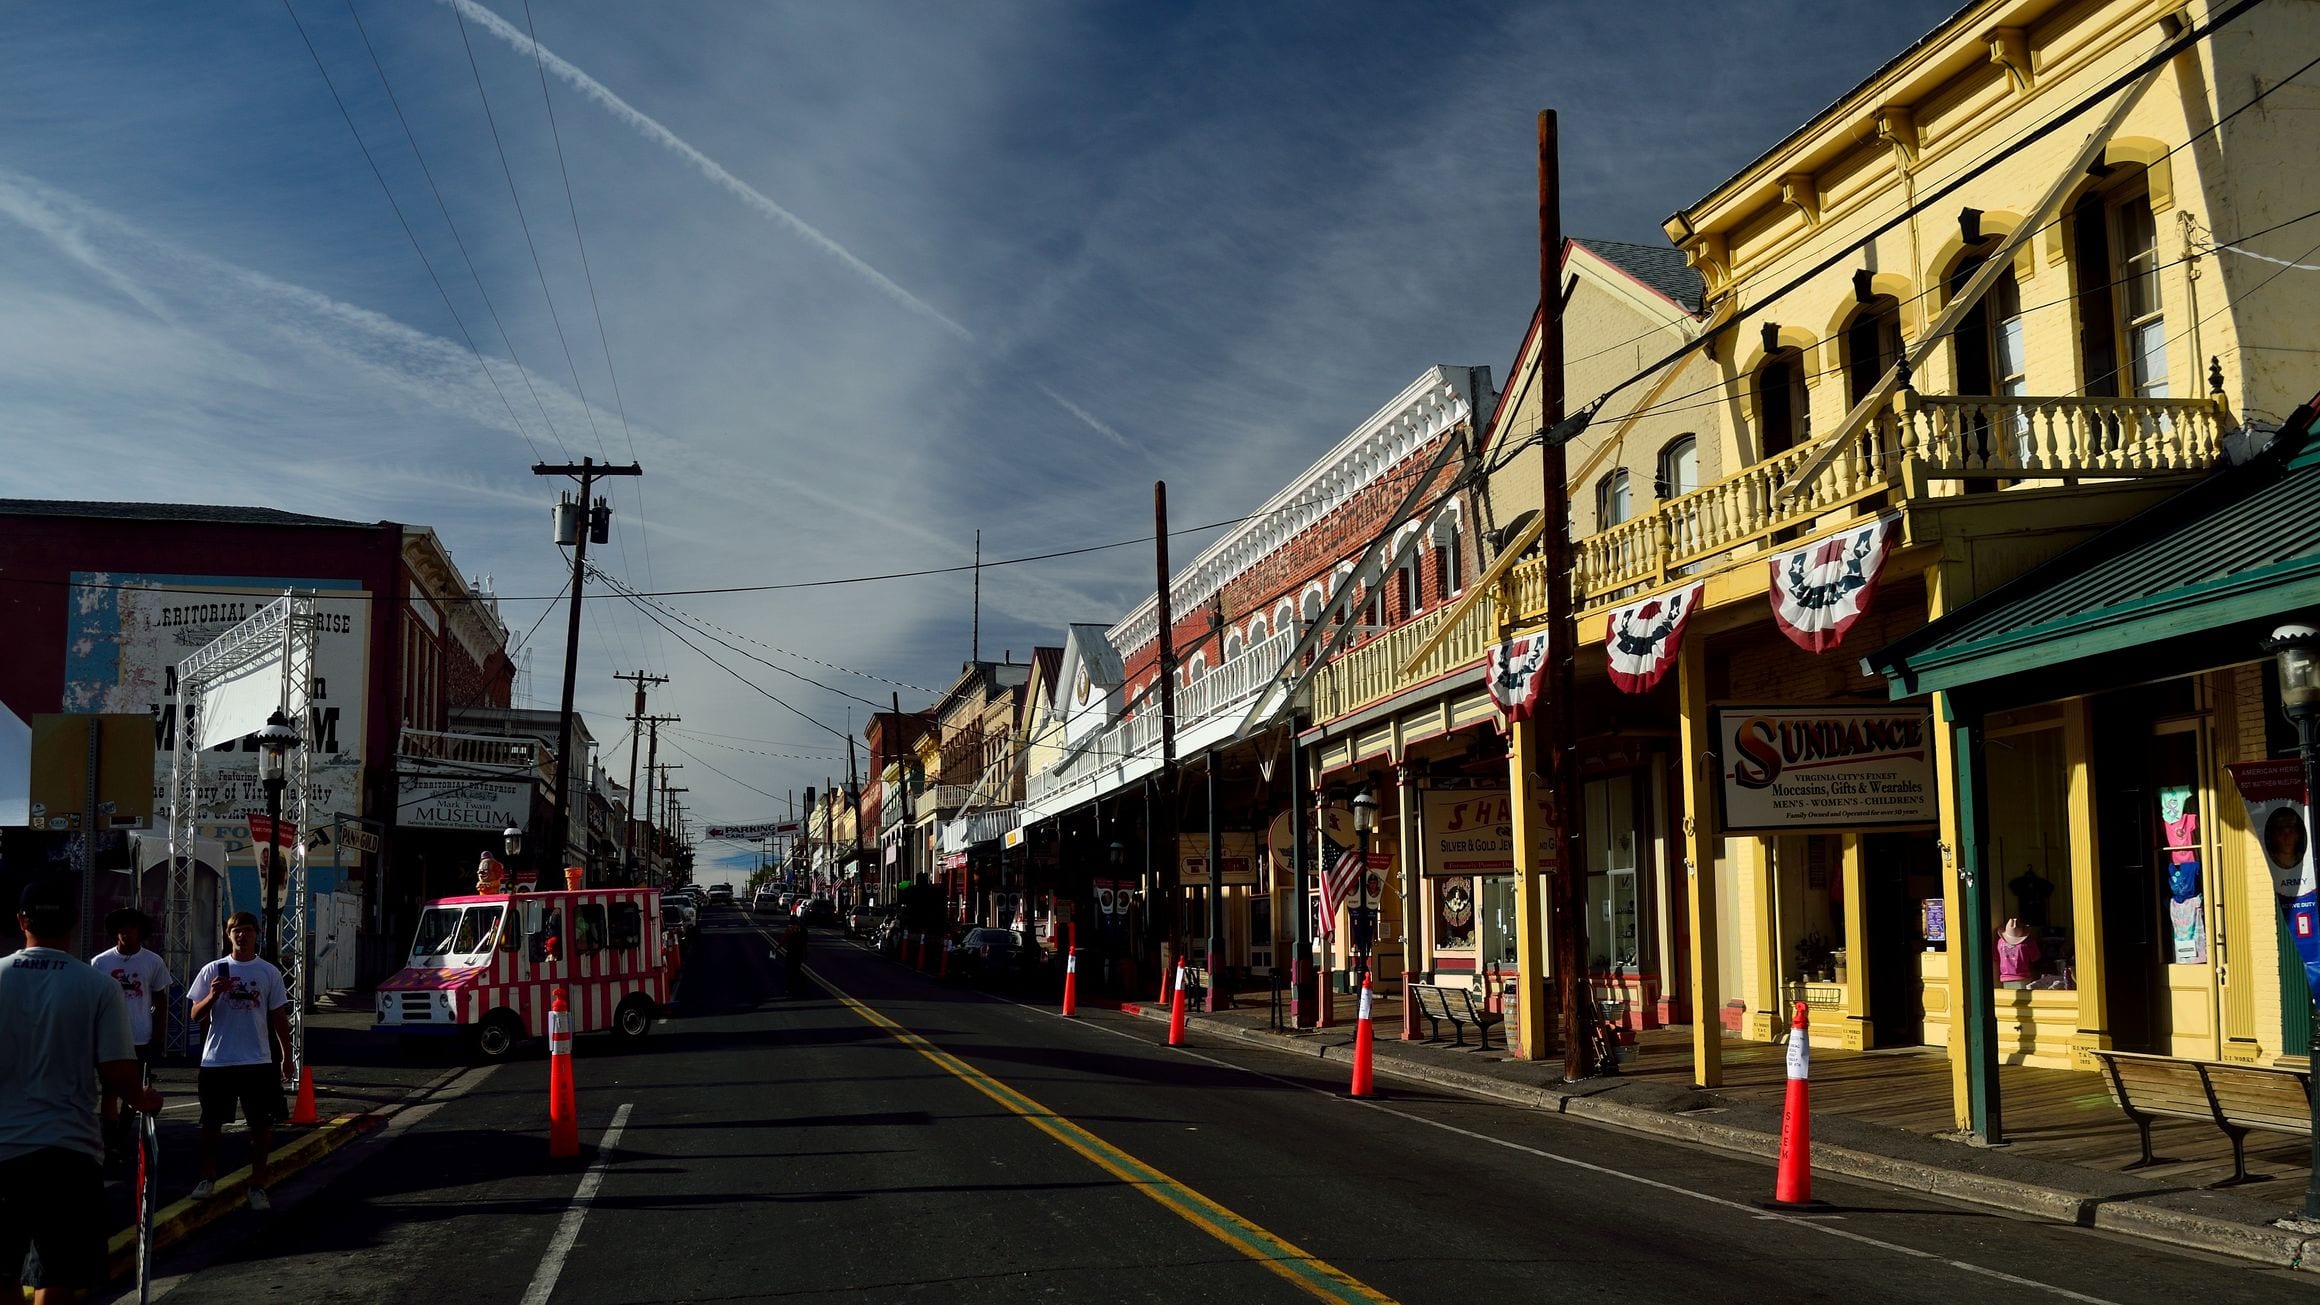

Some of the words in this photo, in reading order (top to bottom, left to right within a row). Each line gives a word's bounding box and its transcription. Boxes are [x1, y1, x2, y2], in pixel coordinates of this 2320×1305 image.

[1321, 484, 1390, 553] CLOTHING
[1735, 716, 1924, 789] SUNDANCE
[219, 769, 258, 787] Featuring
[1795, 774, 1836, 782] VIRGINIA
[1837, 773, 1866, 781] CITY'S
[1866, 772, 1898, 780] FINEST
[2241, 767, 2278, 776] AMERICAN
[309, 784, 332, 805] ity
[1772, 782, 1830, 798] Moccasins,
[1831, 781, 1858, 795] Gifts
[1859, 781, 1868, 793] &
[1871, 779, 1923, 793] Wearables
[437, 800, 461, 808] Mark
[463, 801, 492, 809] Twain
[1773, 799, 1804, 809] MEN'S
[1811, 798, 1859, 808] WOMEN'S
[1865, 795, 1925, 806] CHILDREN'S
[416, 807, 511, 826] MUSEUM
[1786, 812, 1808, 820] Family
[1842, 810, 1871, 818] Operated
[725, 825, 776, 834] PARKING
[360, 834, 377, 851] GOLD
[1441, 839, 1468, 852] SILVER
[1468, 840, 1476, 851] &
[1475, 839, 1497, 851] GOLD
[2280, 879, 2308, 887] ARMY
[12, 959, 50, 970] EARN
[51, 959, 69, 970] IT
